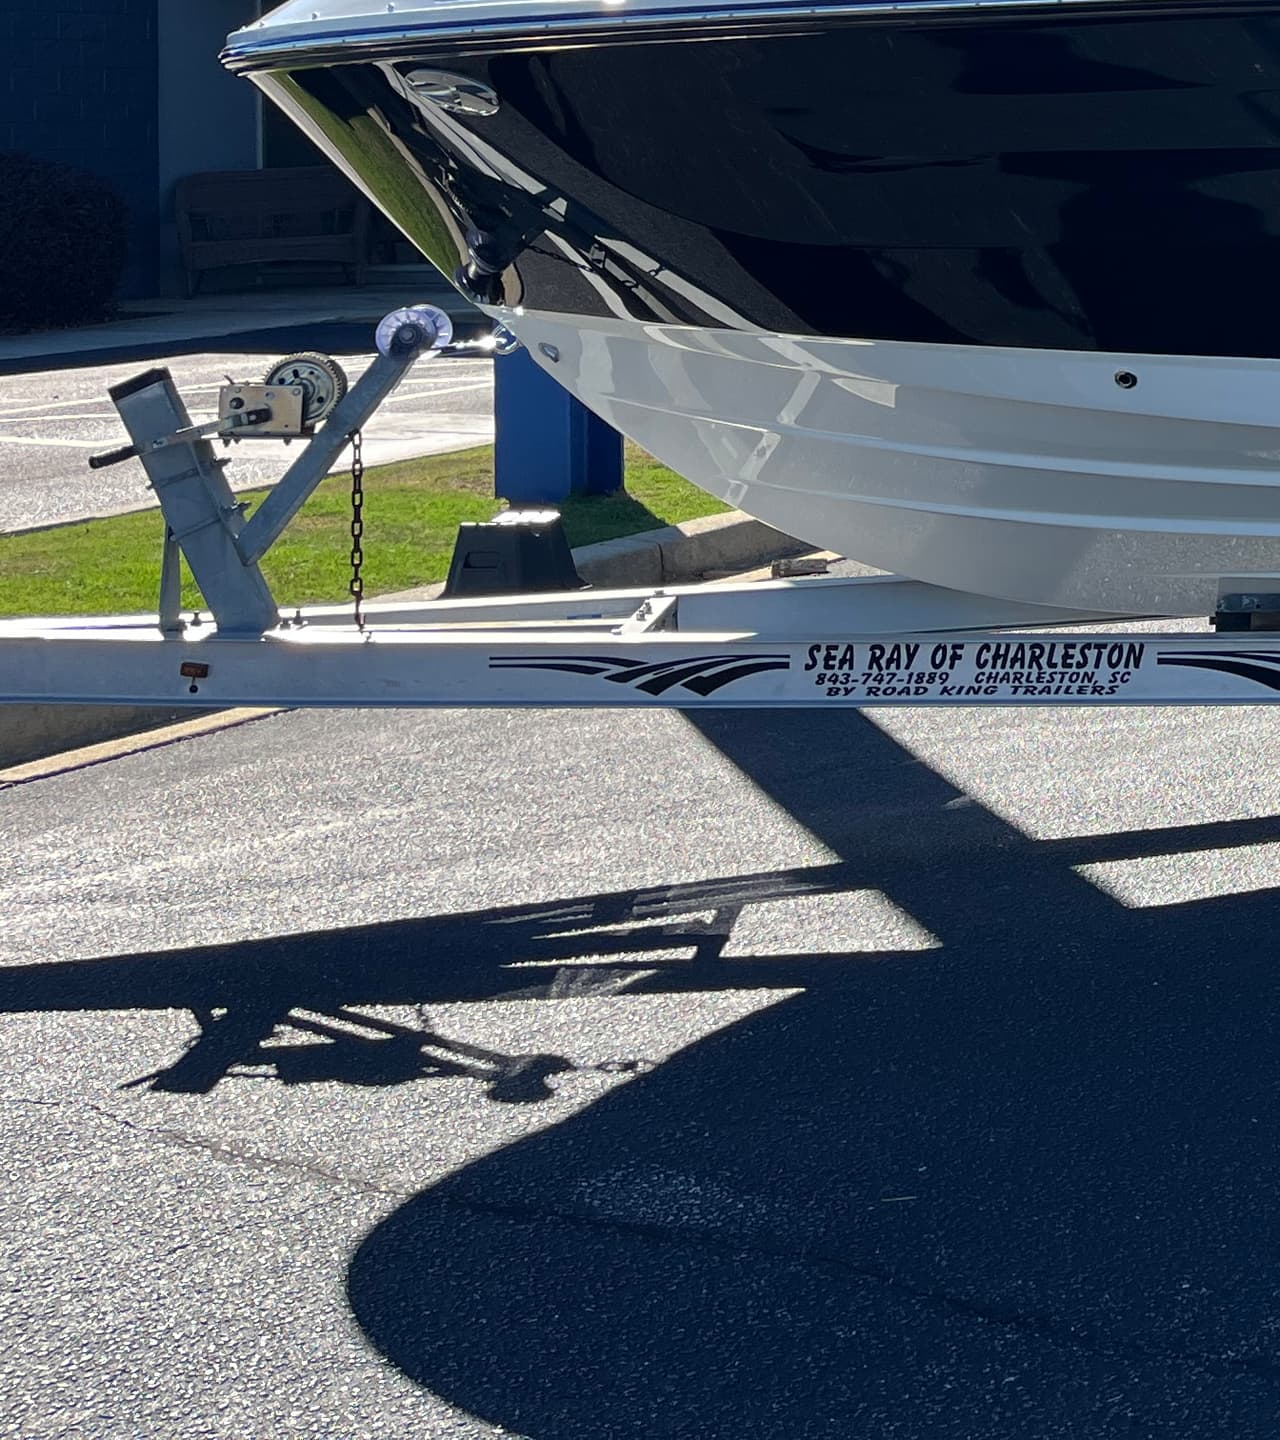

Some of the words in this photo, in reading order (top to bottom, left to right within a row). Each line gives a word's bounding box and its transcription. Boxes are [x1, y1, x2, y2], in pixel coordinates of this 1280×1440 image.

[804, 643, 855, 672] SEA
[867, 643, 921, 672] RAY
[930, 642, 965, 671] OF
[975, 642, 1145, 671] CHARLESTON
[815, 672, 950, 686] 843-747-1889
[974, 671, 1099, 686] CHARLESTON,
[1108, 671, 1132, 684] SC
[826, 686, 857, 696] BY
[865, 686, 929, 697] ROAD
[939, 685, 998, 696] KING
[1010, 685, 1120, 696] TRAILERS
